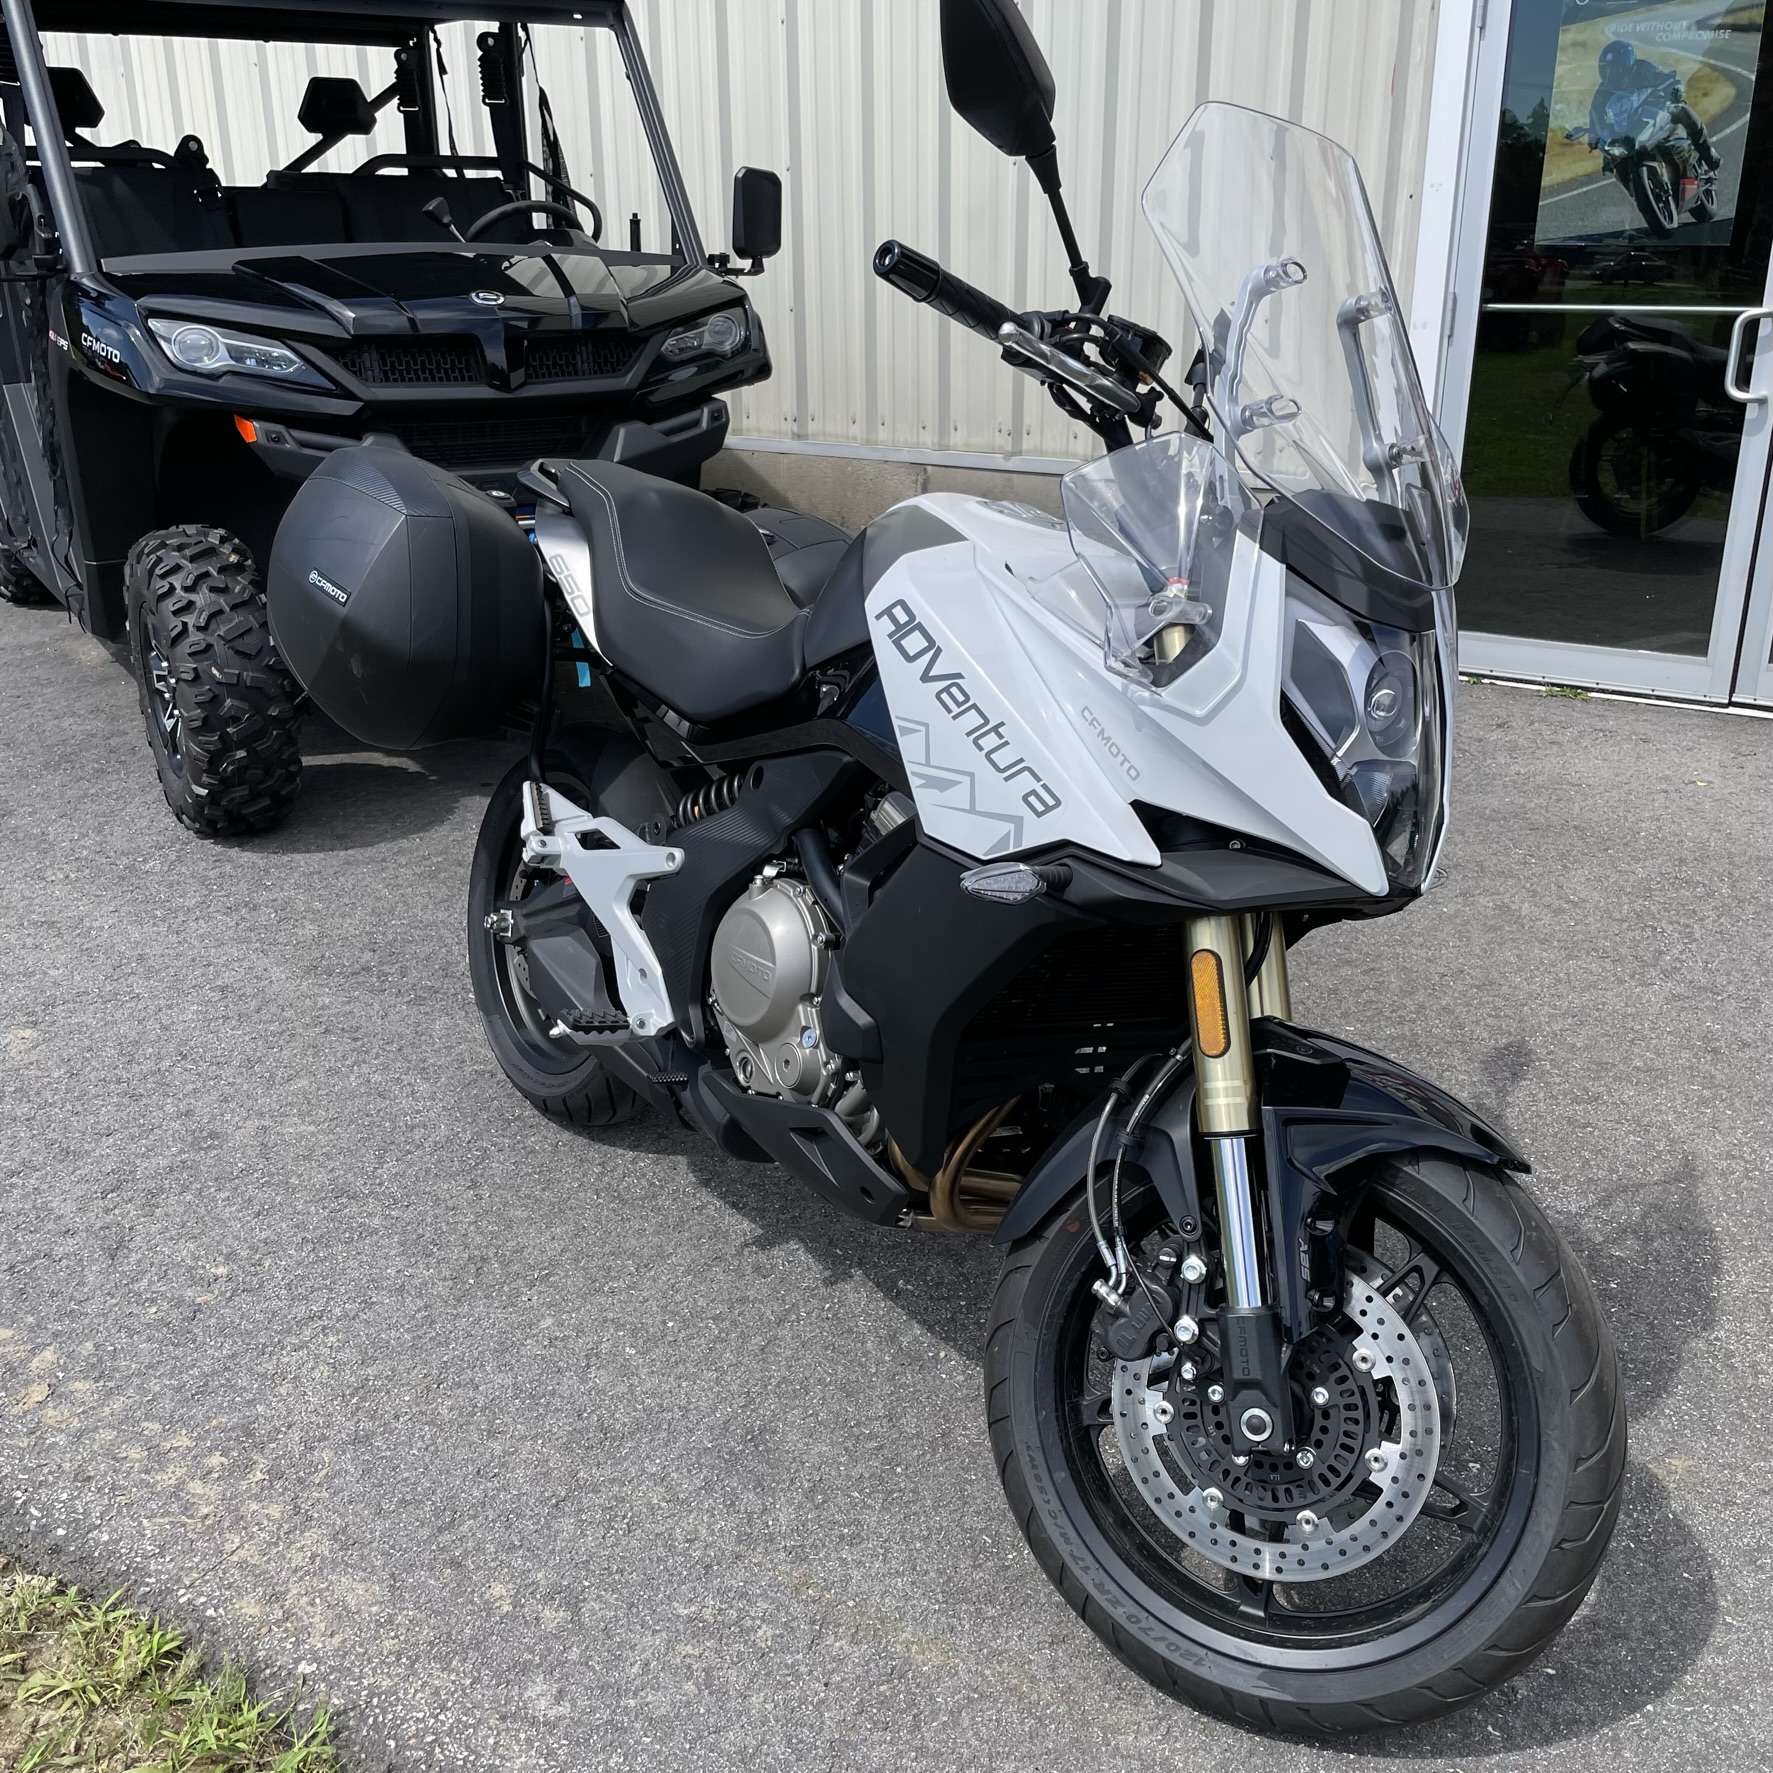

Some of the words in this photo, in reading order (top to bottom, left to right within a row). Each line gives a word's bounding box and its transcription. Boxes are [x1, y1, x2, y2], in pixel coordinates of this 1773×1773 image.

[1610, 21, 1634, 33] RIDE
[1636, 20, 1688, 32] WITHOUT
[1656, 29, 1732, 42] COMPROMISE
[56, 335, 69, 351] EPS
[81, 332, 121, 364] CFMOTO
[315, 576, 347, 602] CFMOTO
[548, 553, 591, 617] 650
[1080, 705, 1141, 782] CFMOTO
[1298, 1237, 1311, 1282] ABS
